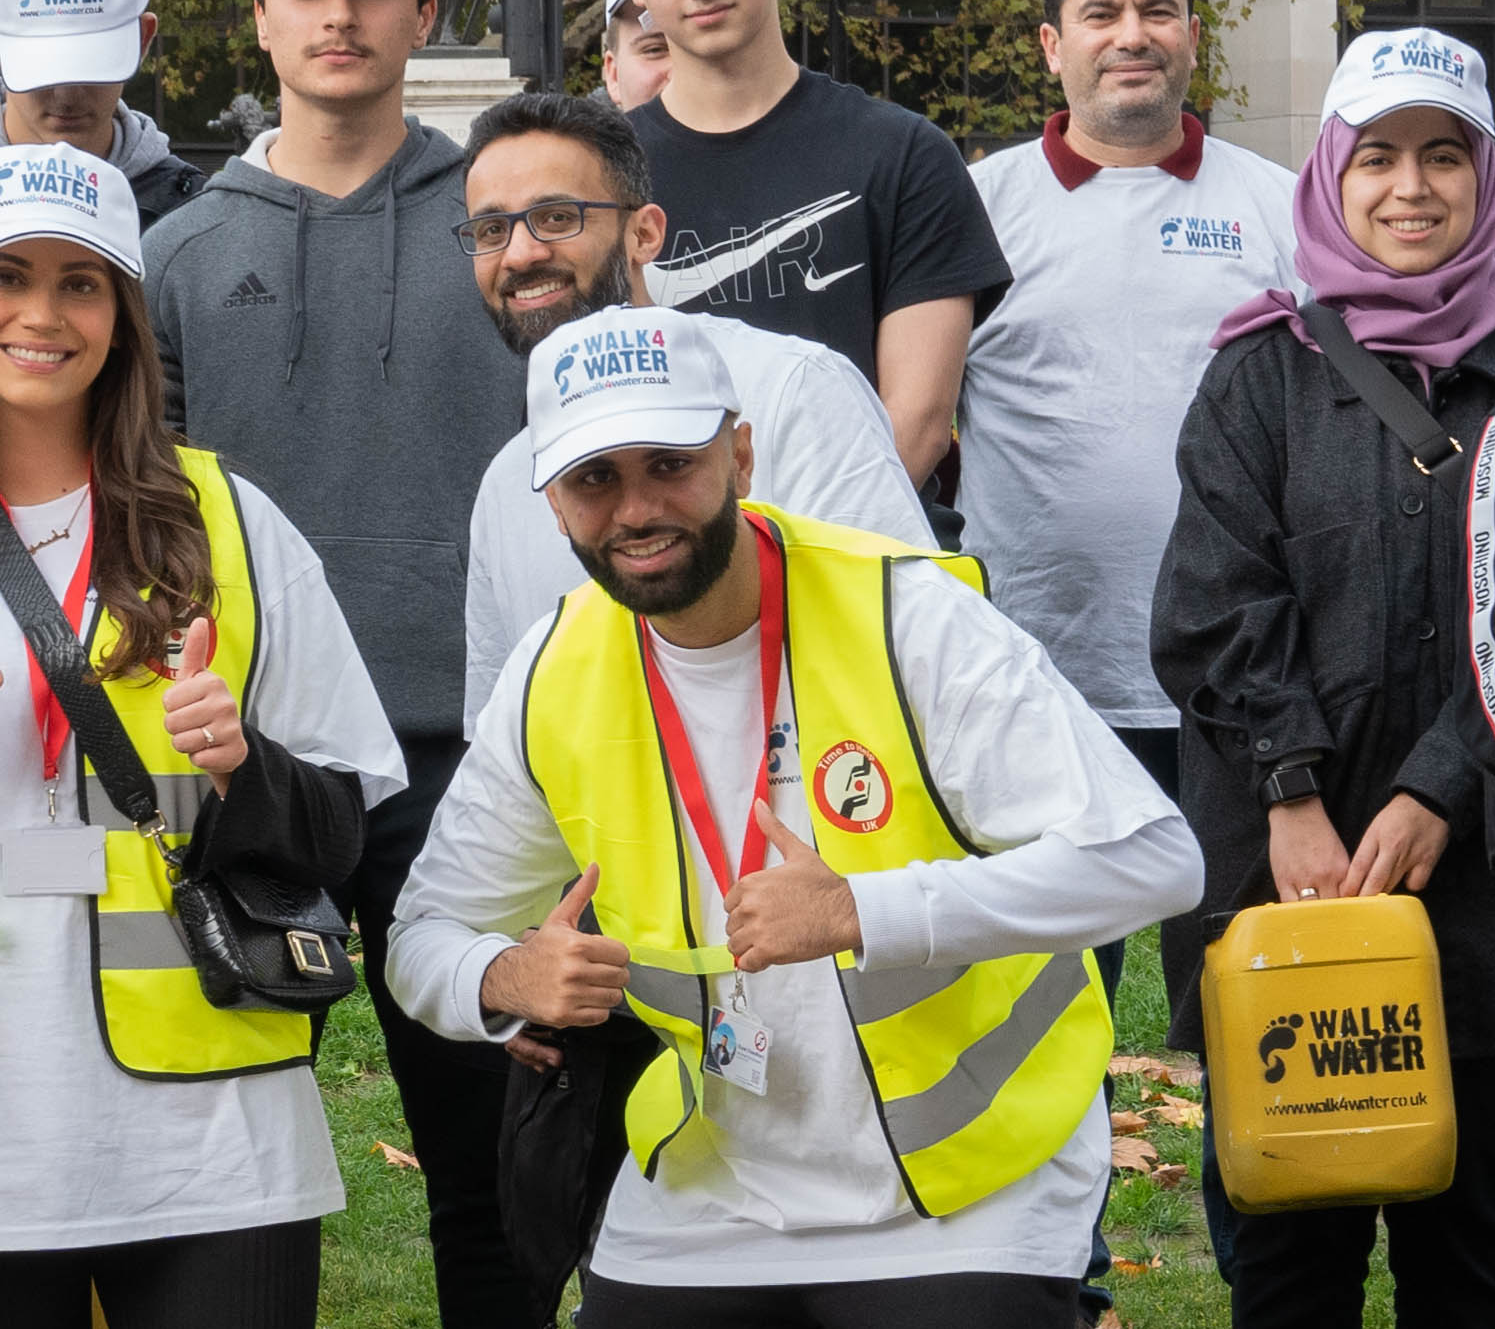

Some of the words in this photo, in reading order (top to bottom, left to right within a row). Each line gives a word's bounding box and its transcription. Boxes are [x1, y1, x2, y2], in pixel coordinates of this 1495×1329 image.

[1400, 49, 1465, 80] WATER
[26, 157, 98, 187] WALK4
[21, 171, 98, 208] WATER
[1184, 230, 1242, 251] WATER
[1186, 216, 1241, 235] WALK4
[660, 213, 825, 307] AIR
[223, 292, 277, 309] adidas
[584, 329, 665, 355] WALK4
[583, 349, 669, 381] WATER
[1474, 530, 1489, 615] MOSCHINO
[818, 743, 846, 771] Time
[844, 741, 857, 752] to
[861, 821, 879, 832] UK
[1309, 1002, 1423, 1041] WALK4
[1307, 1035, 1427, 1079] WATER
